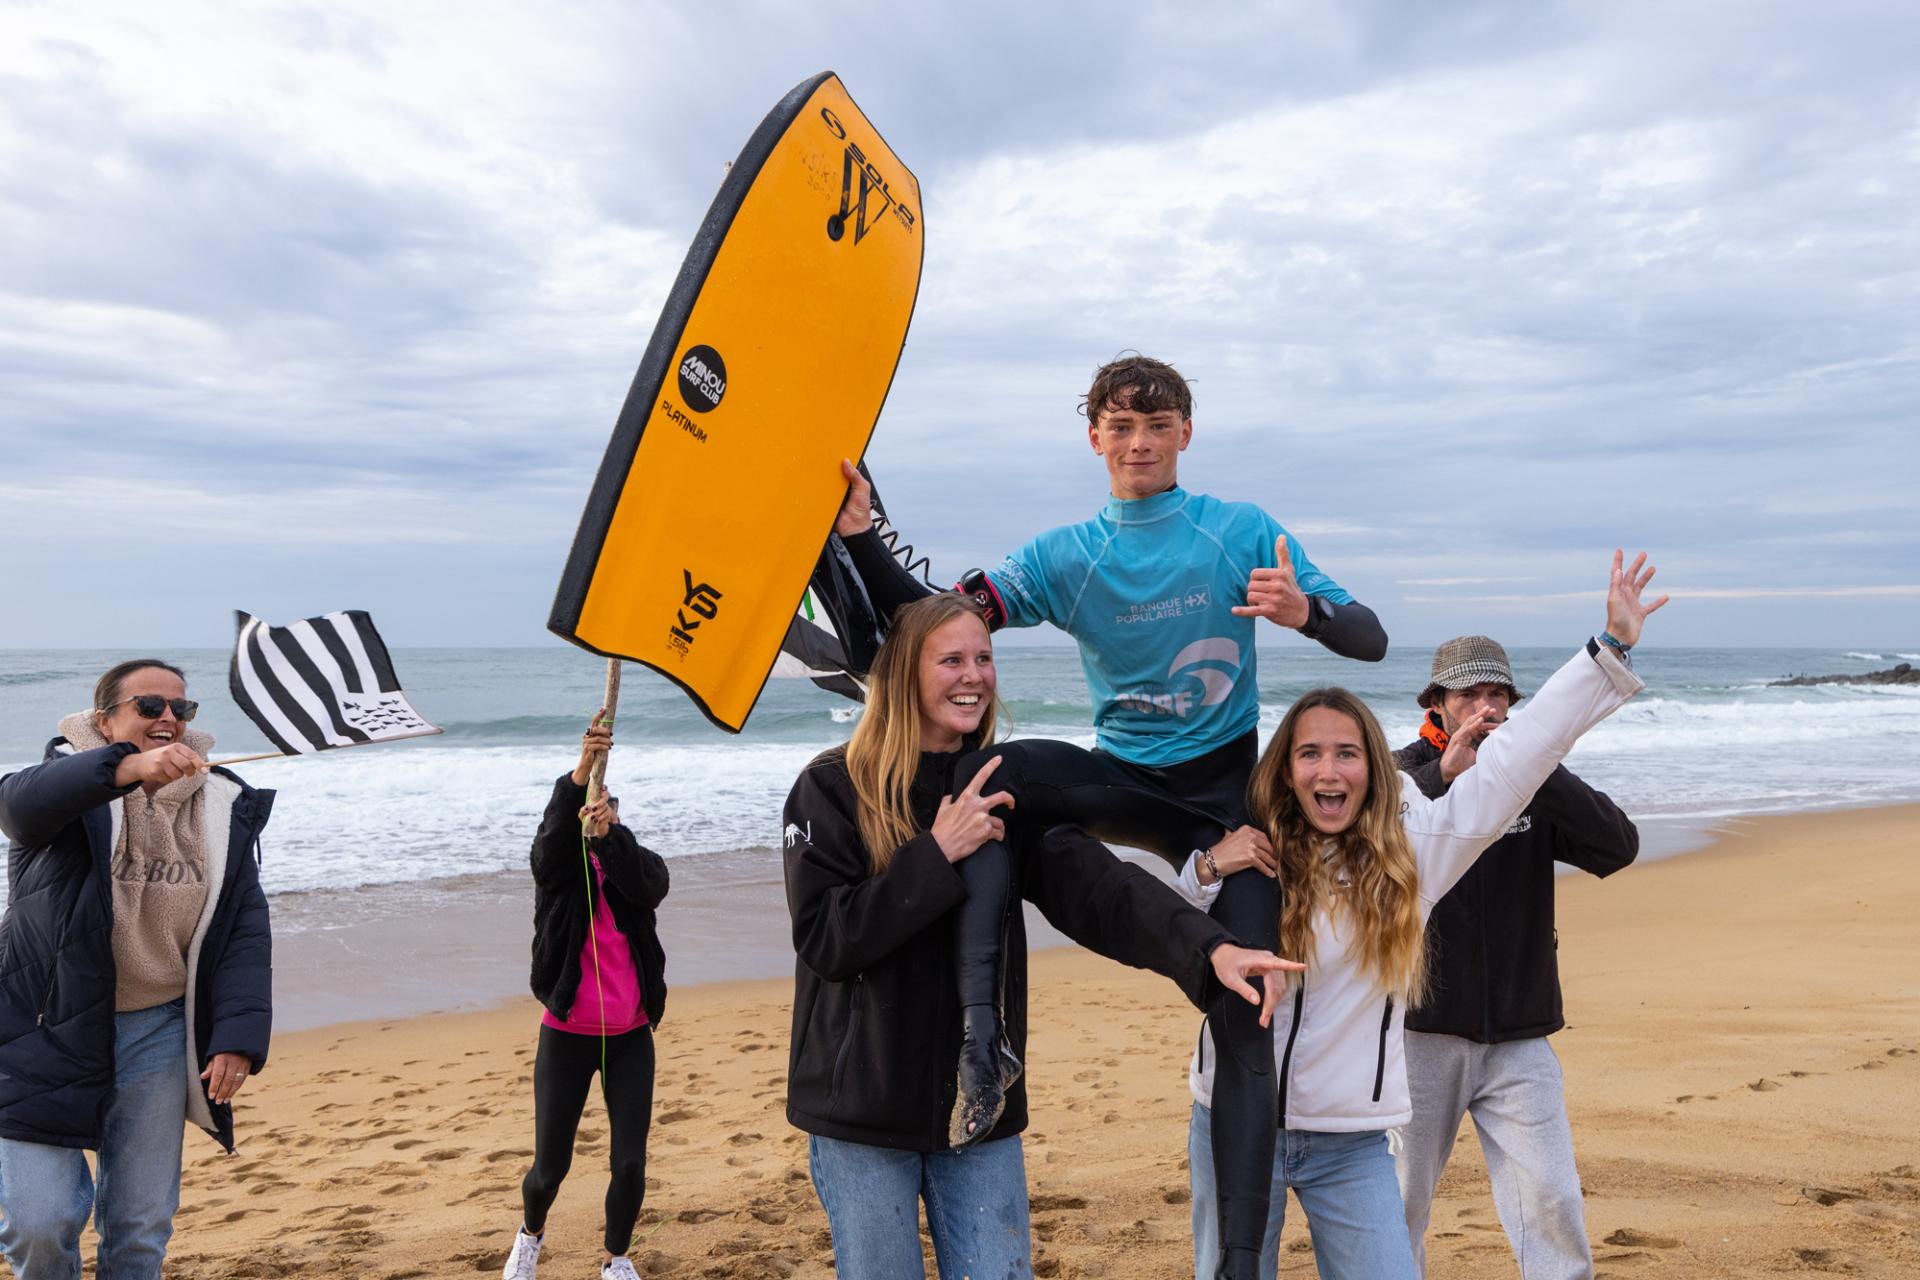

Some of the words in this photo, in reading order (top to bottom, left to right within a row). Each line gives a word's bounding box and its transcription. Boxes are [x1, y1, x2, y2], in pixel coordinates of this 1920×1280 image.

[849, 142, 915, 226] SOLA
[680, 364, 702, 387] SURF
[700, 382, 720, 405] CLUB
[684, 355, 726, 395] MINOU
[661, 400, 708, 443] PLATINUM
[1115, 607, 1184, 625] POPULAIRE
[1130, 597, 1182, 614] BANQUE
